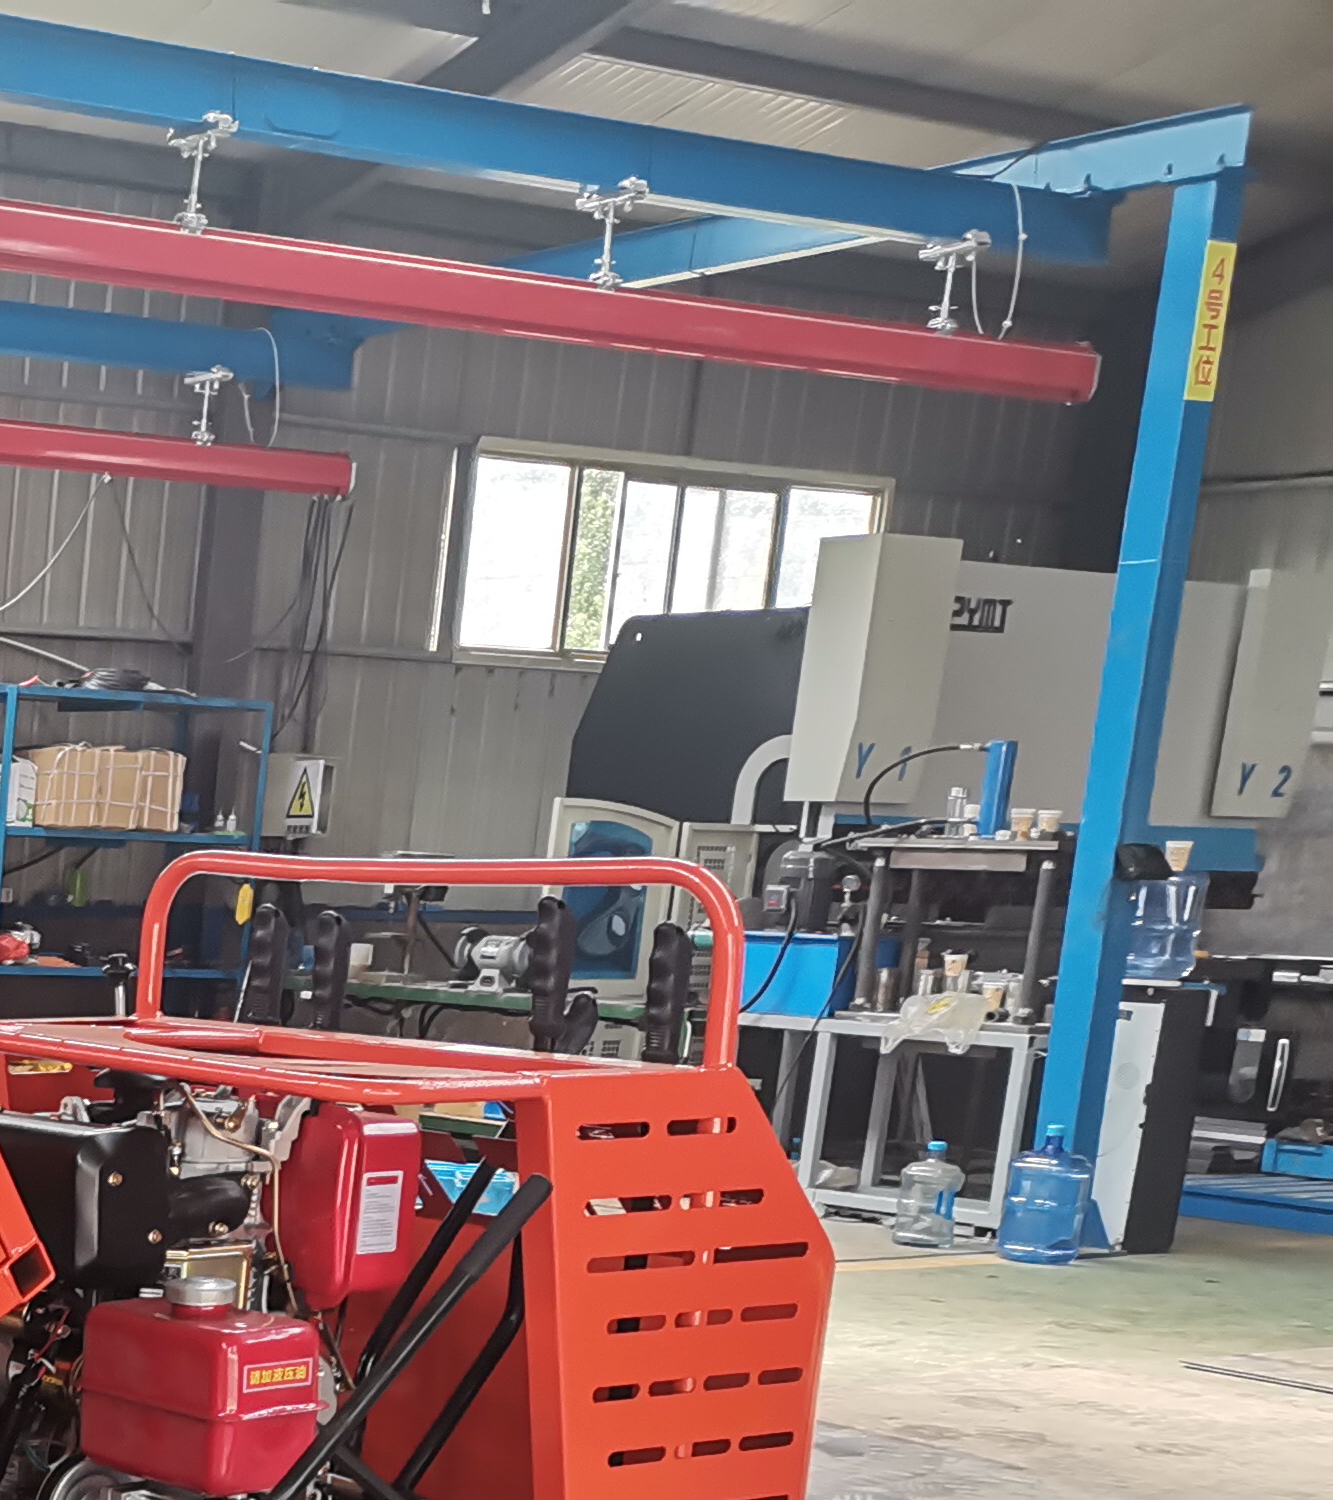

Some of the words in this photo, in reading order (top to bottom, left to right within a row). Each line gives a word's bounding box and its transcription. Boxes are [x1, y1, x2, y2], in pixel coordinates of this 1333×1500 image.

[1194, 257, 1226, 386] 4号工位
[856, 742, 876, 779] Y
[1237, 762, 1258, 796] Y
[1271, 765, 1292, 797] 2
